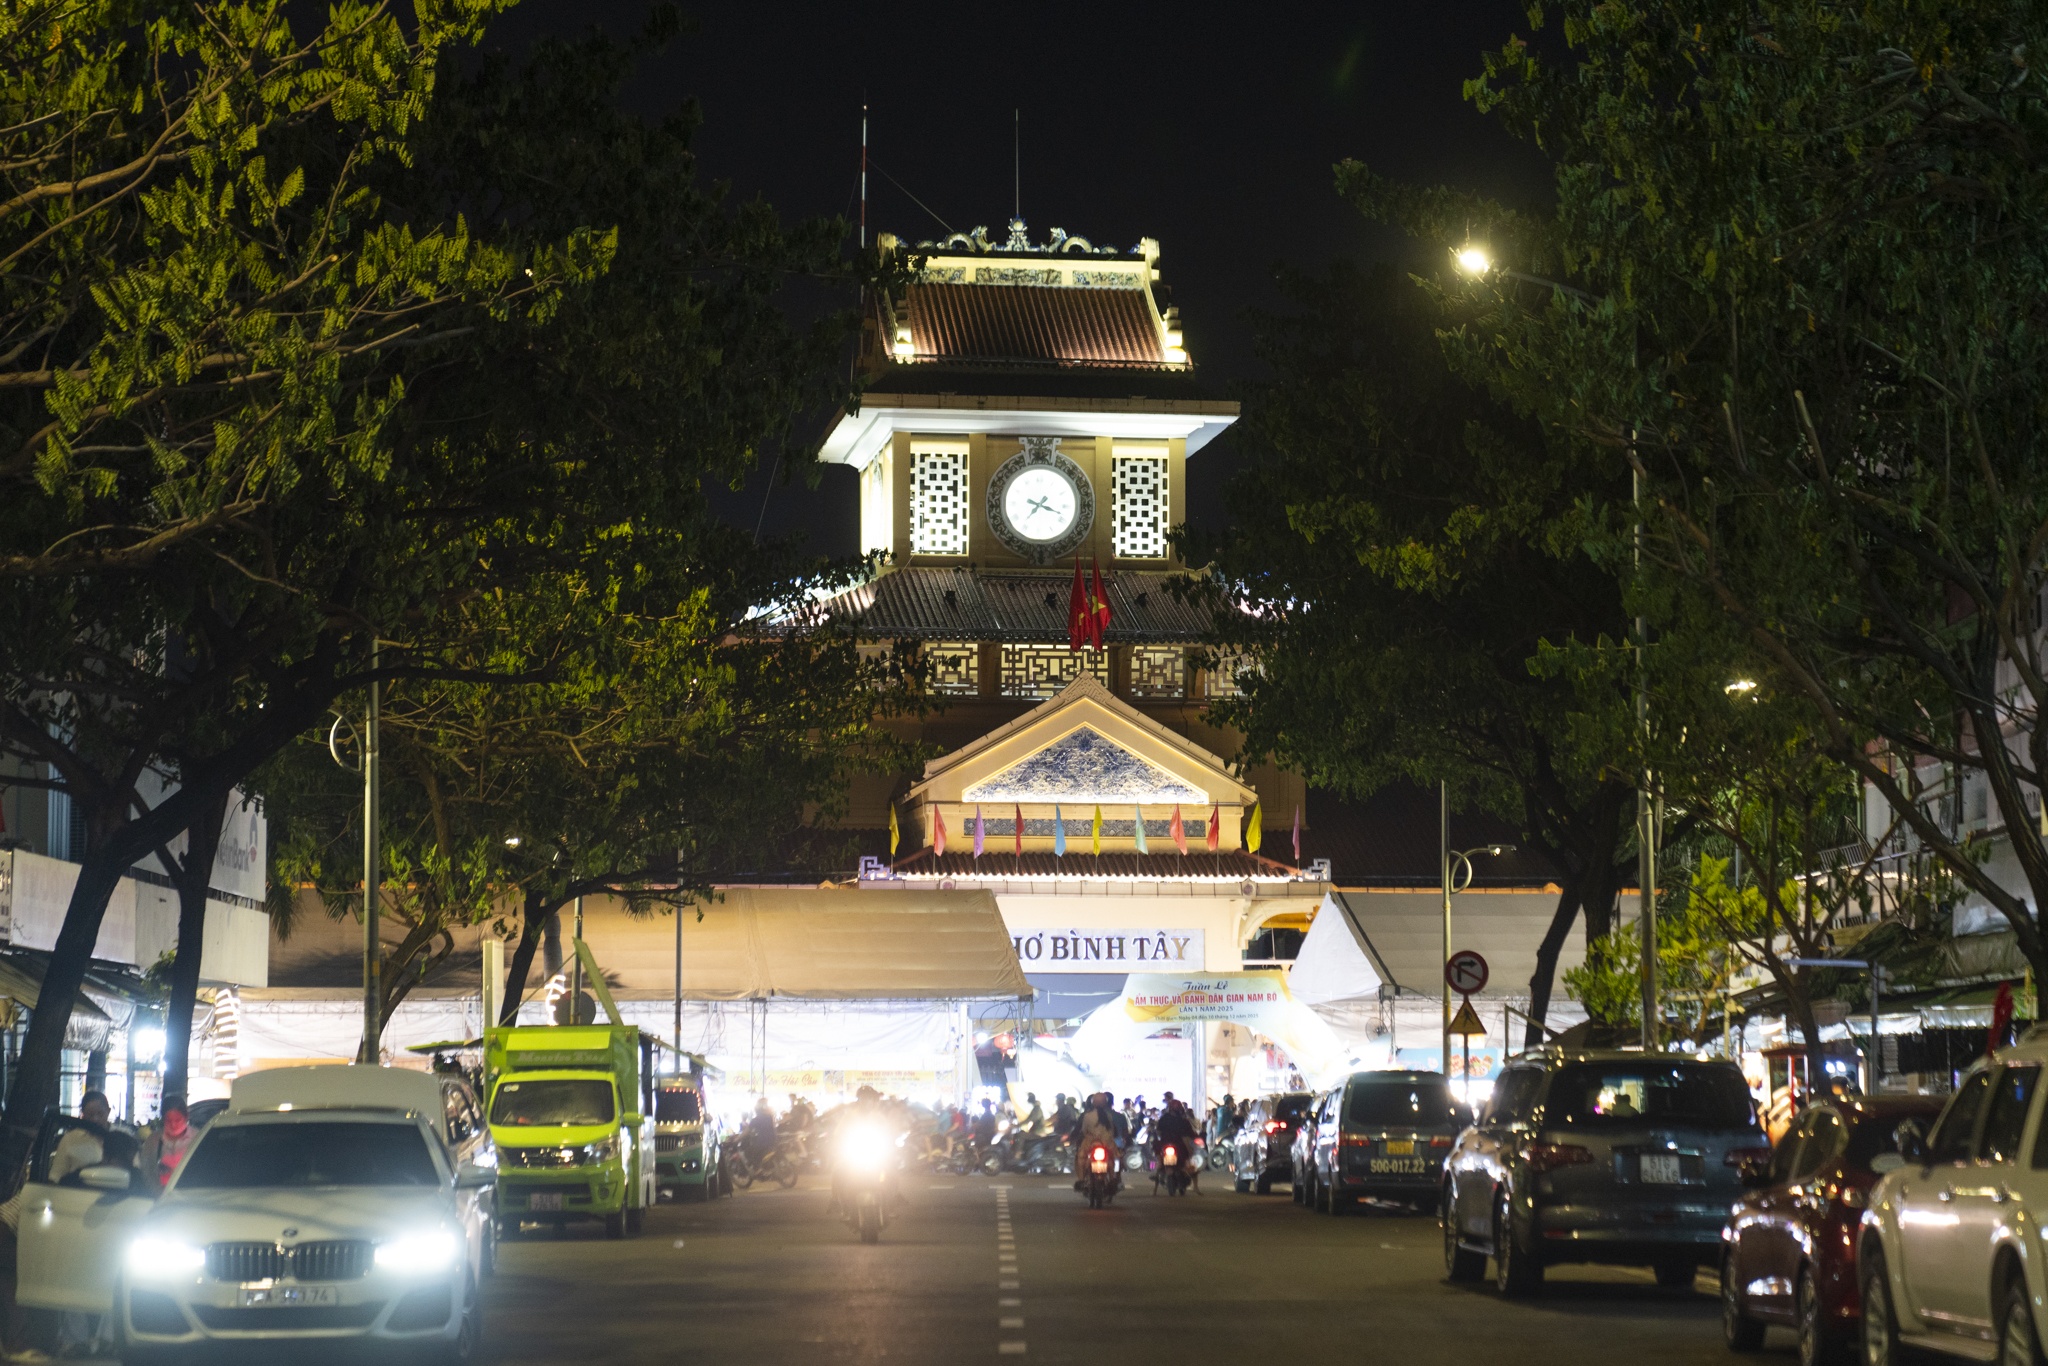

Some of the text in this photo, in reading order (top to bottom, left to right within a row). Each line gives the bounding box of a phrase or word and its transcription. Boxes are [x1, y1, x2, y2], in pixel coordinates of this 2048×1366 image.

[1050, 929, 1127, 960] BÌNH
[1132, 930, 1190, 960] TÂY
[1226, 993, 1245, 1003] GIAN
[1247, 992, 1264, 1003] NAM
